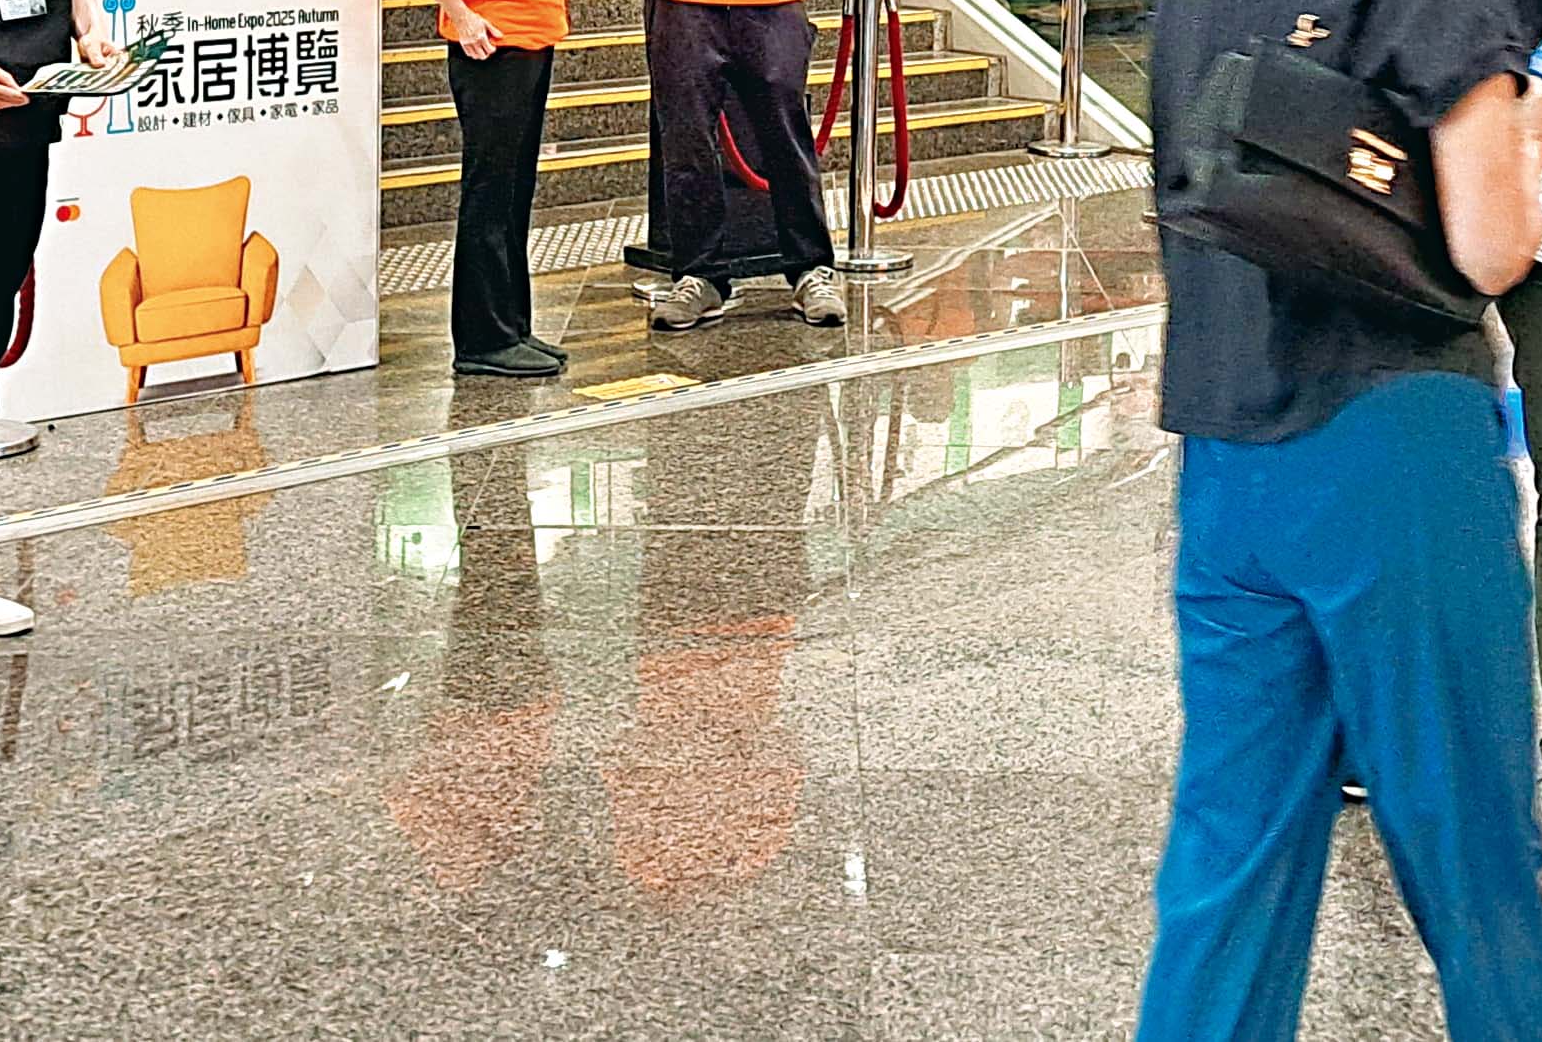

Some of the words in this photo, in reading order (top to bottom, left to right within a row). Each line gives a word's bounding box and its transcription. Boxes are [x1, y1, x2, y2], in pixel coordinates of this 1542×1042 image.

[137, 11, 184, 38] 秋季
[187, 15, 236, 32] In-Home
[238, 12, 265, 30] Expo
[266, 9, 295, 27] 2025
[297, 8, 339, 25] Autumn
[137, 28, 339, 108] 家居博覽
